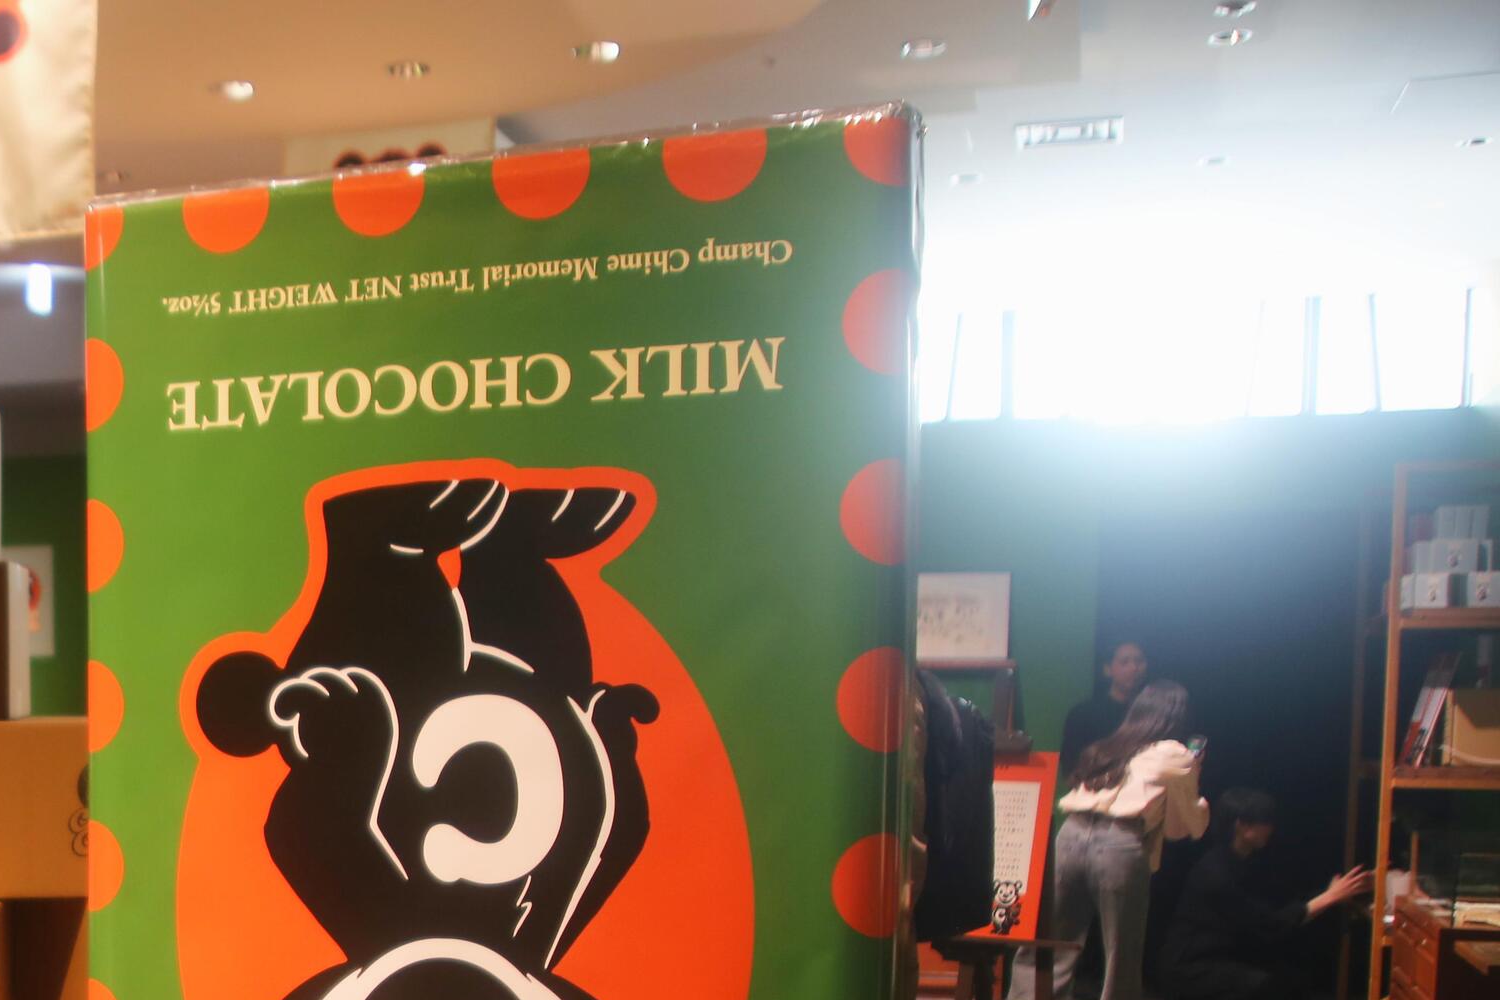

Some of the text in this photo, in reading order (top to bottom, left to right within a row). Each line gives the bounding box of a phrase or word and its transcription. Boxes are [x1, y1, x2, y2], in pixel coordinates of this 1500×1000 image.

[606, 248, 691, 274] Chime
[698, 237, 794, 265] Champ
[409, 268, 475, 293] Trust
[482, 256, 599, 290] Memorial
[227, 282, 339, 314] WEIGHT
[345, 275, 402, 302] NET
[165, 336, 786, 431] MILK CHOCOLATE
